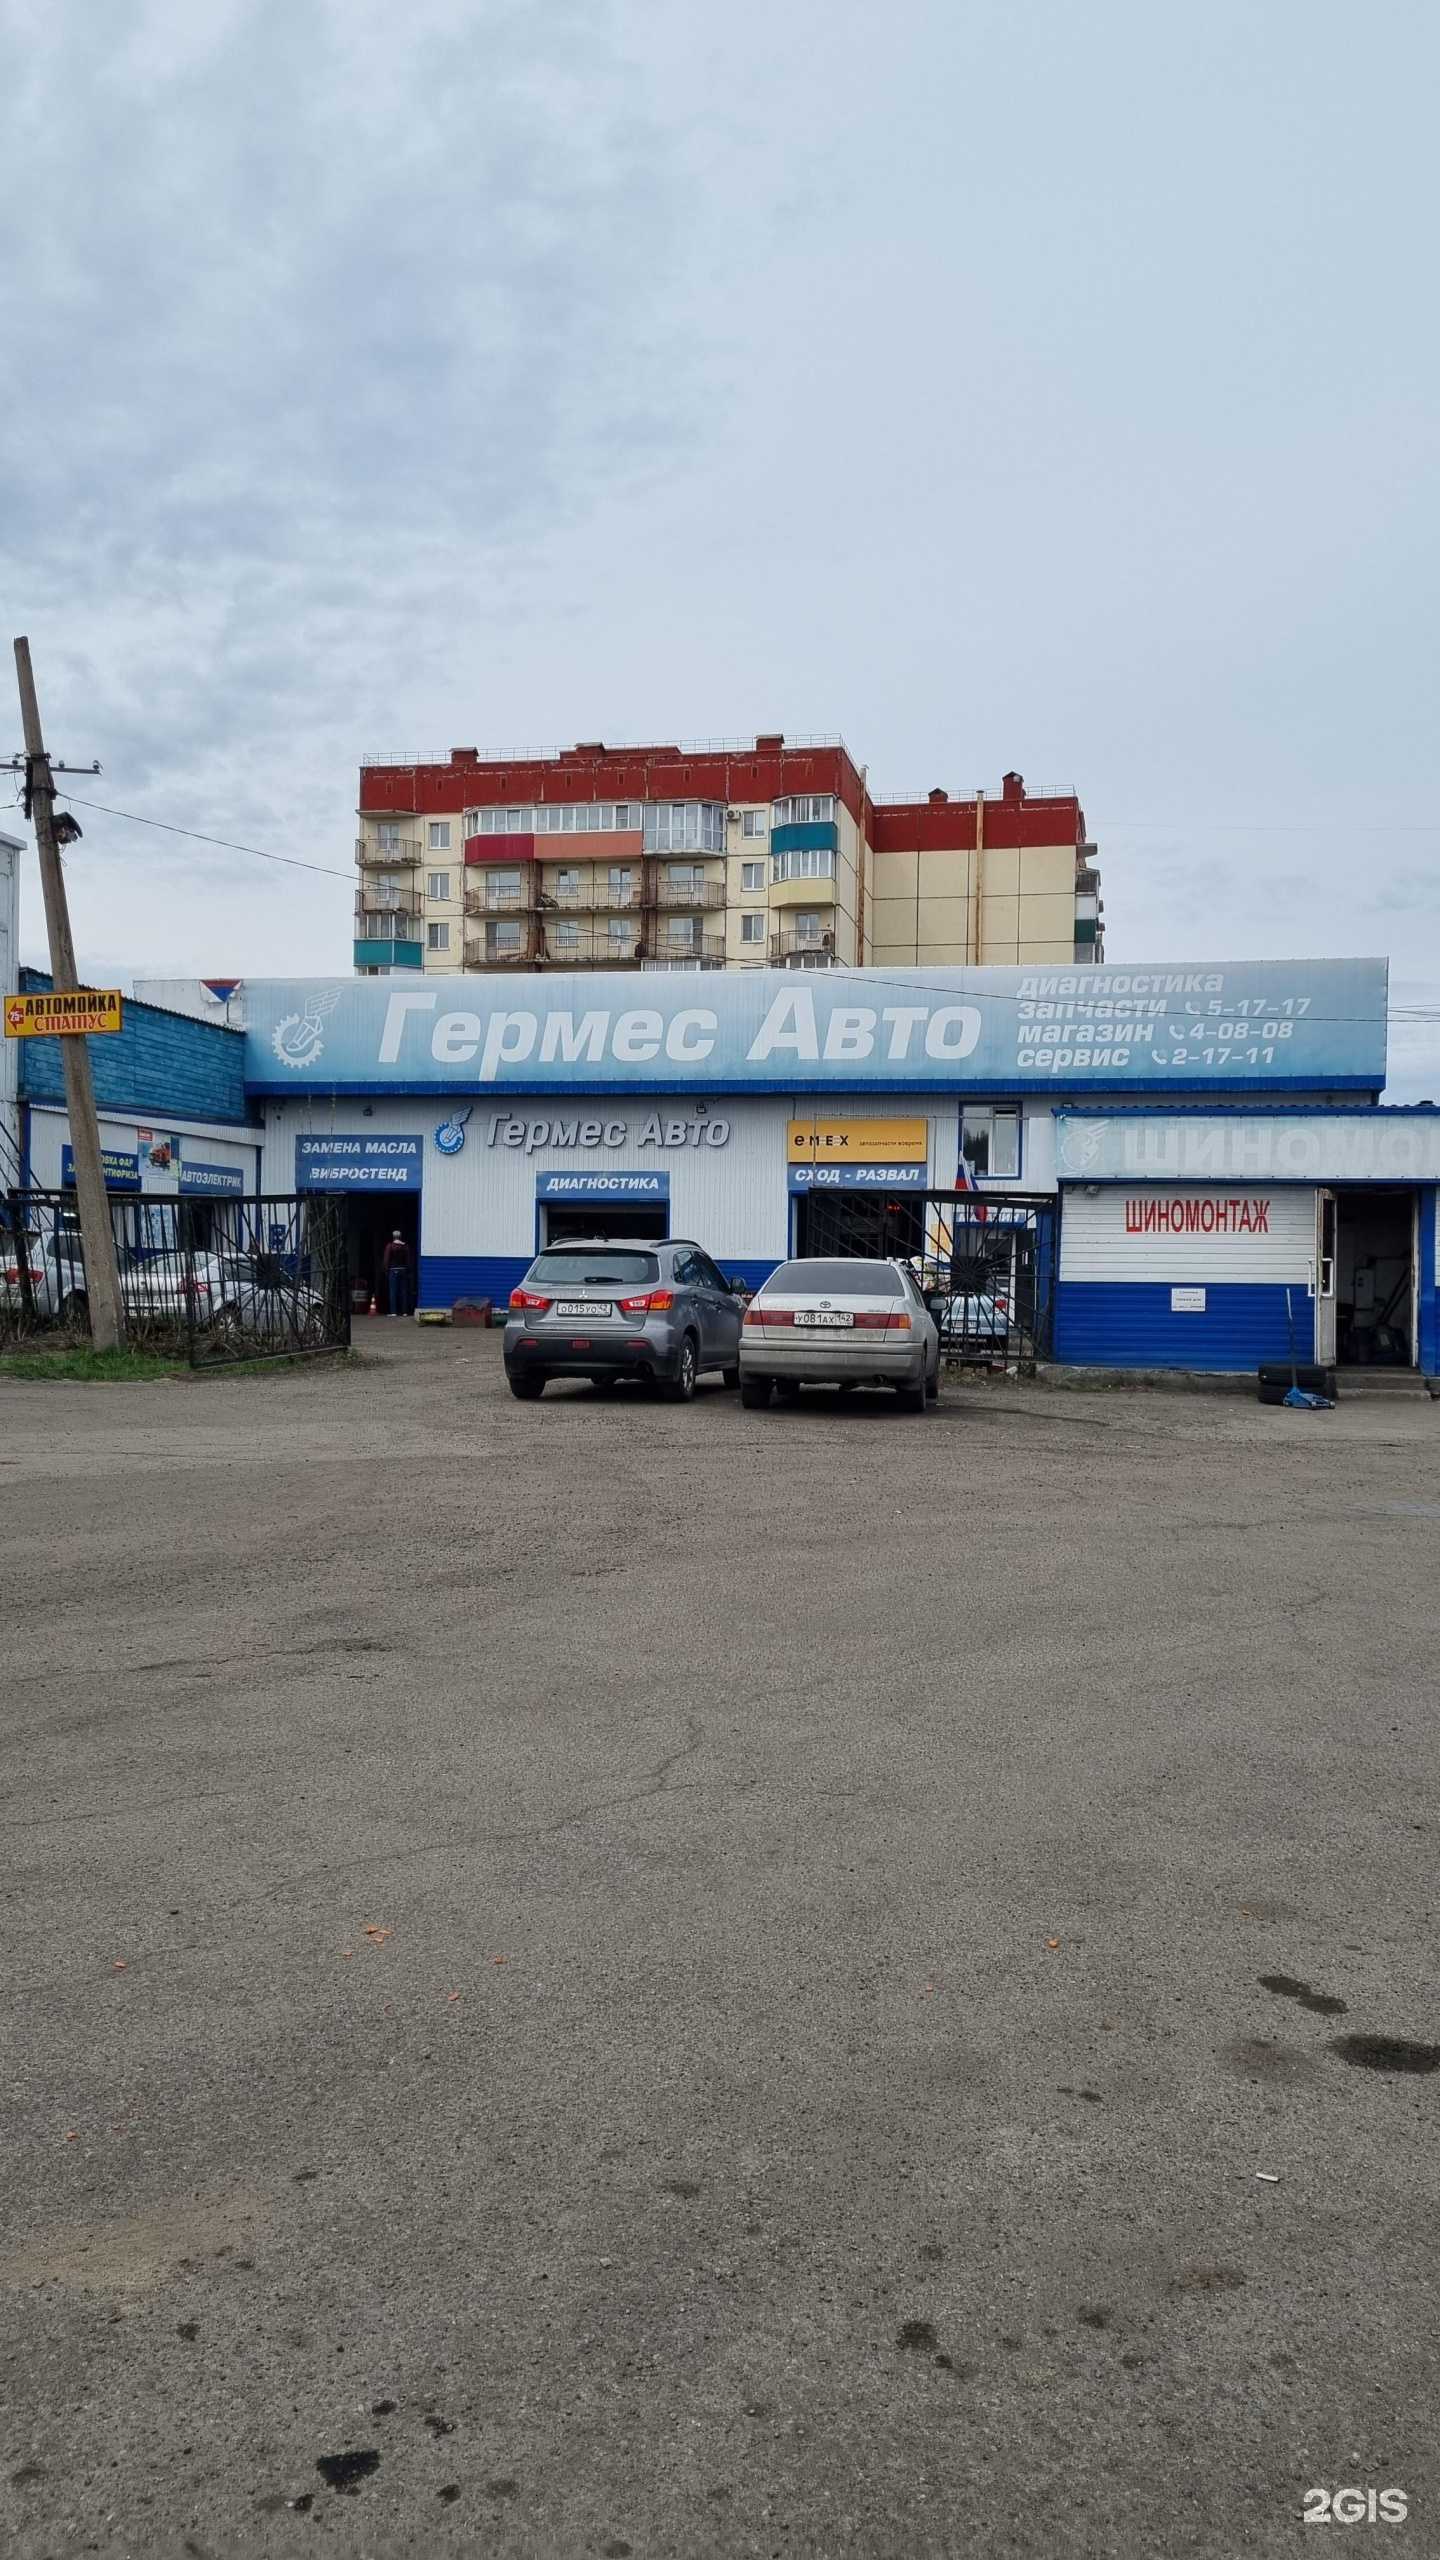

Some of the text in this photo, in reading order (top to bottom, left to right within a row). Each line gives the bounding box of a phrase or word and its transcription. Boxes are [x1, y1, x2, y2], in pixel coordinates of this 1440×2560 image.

[1016, 973, 1224, 999] диагностика
[25, 994, 117, 1017] АВТОМОЙКА
[1017, 998, 1312, 1020] запчасти 5-17-17
[378, 986, 982, 1081] Гермес Авто
[1017, 1022, 1294, 1043] магазин 4-08-08
[1017, 1046, 1275, 1074] сервис 2-17-11
[487, 1112, 731, 1155] Гермес Авто
[301, 1142, 416, 1154] ЗАМЕНА МАСЛА
[1123, 1128, 1440, 1170] ШИНОМО
[182, 1170, 242, 1188] АВТОЭЛЕКТРИК
[310, 1167, 408, 1181] ВИБРОСТЕНД
[547, 1178, 659, 1190] ДИАГНОСТИКА
[795, 1169, 840, 1183] СХОД
[855, 1169, 919, 1181] РАЗВАЛ
[1125, 1200, 1270, 1233] ШИНОМОНТАЖ
